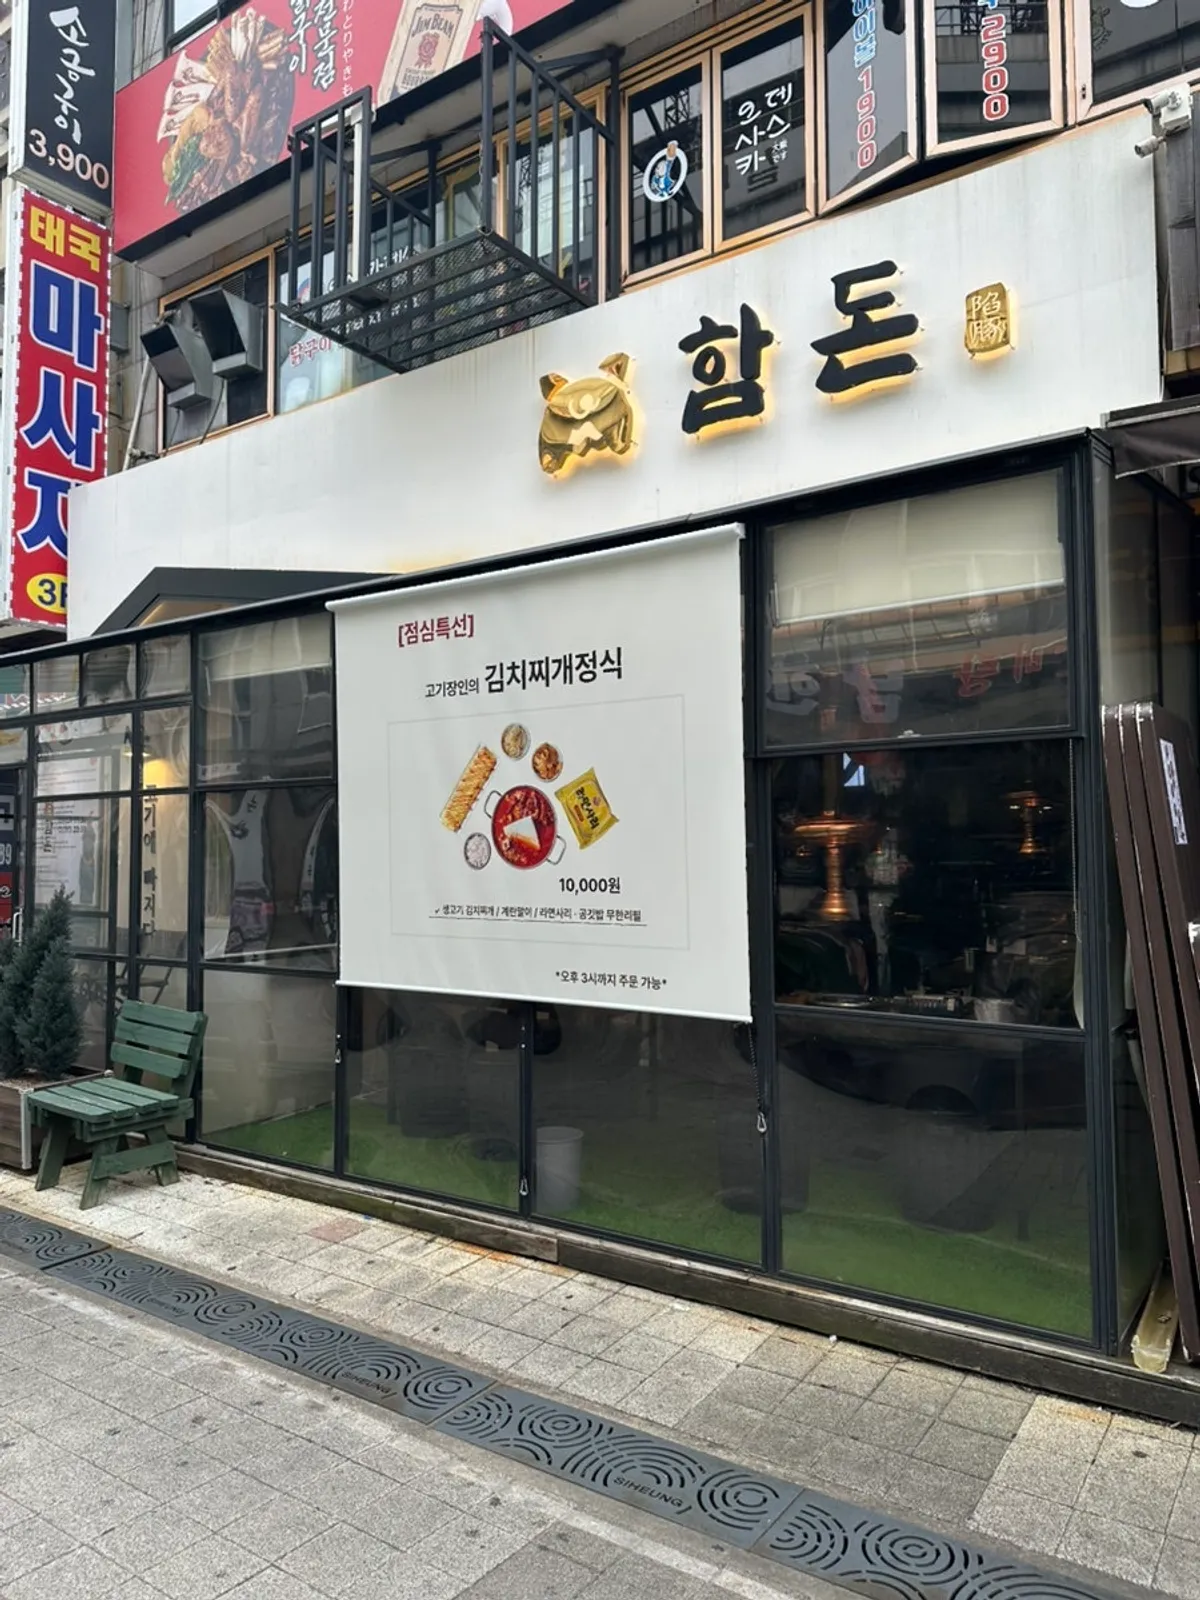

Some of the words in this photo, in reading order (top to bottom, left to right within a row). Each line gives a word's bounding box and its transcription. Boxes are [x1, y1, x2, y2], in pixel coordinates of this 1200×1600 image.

[981, 14, 1009, 121] 2900
[857, 65, 877, 169] 1900
[29, 128, 110, 190] 3,900
[30, 205, 102, 273] 태국
[398, 614, 475, 648] [점심특선]
[425, 678, 480, 698] 고기장인의
[485, 647, 623, 694] 김치찌개정식
[558, 877, 621, 896] 10,000원
[580, 972, 617, 987] 3시까지
[618, 974, 639, 988] 주문
[613, 1476, 684, 1507] SIHEUNG
